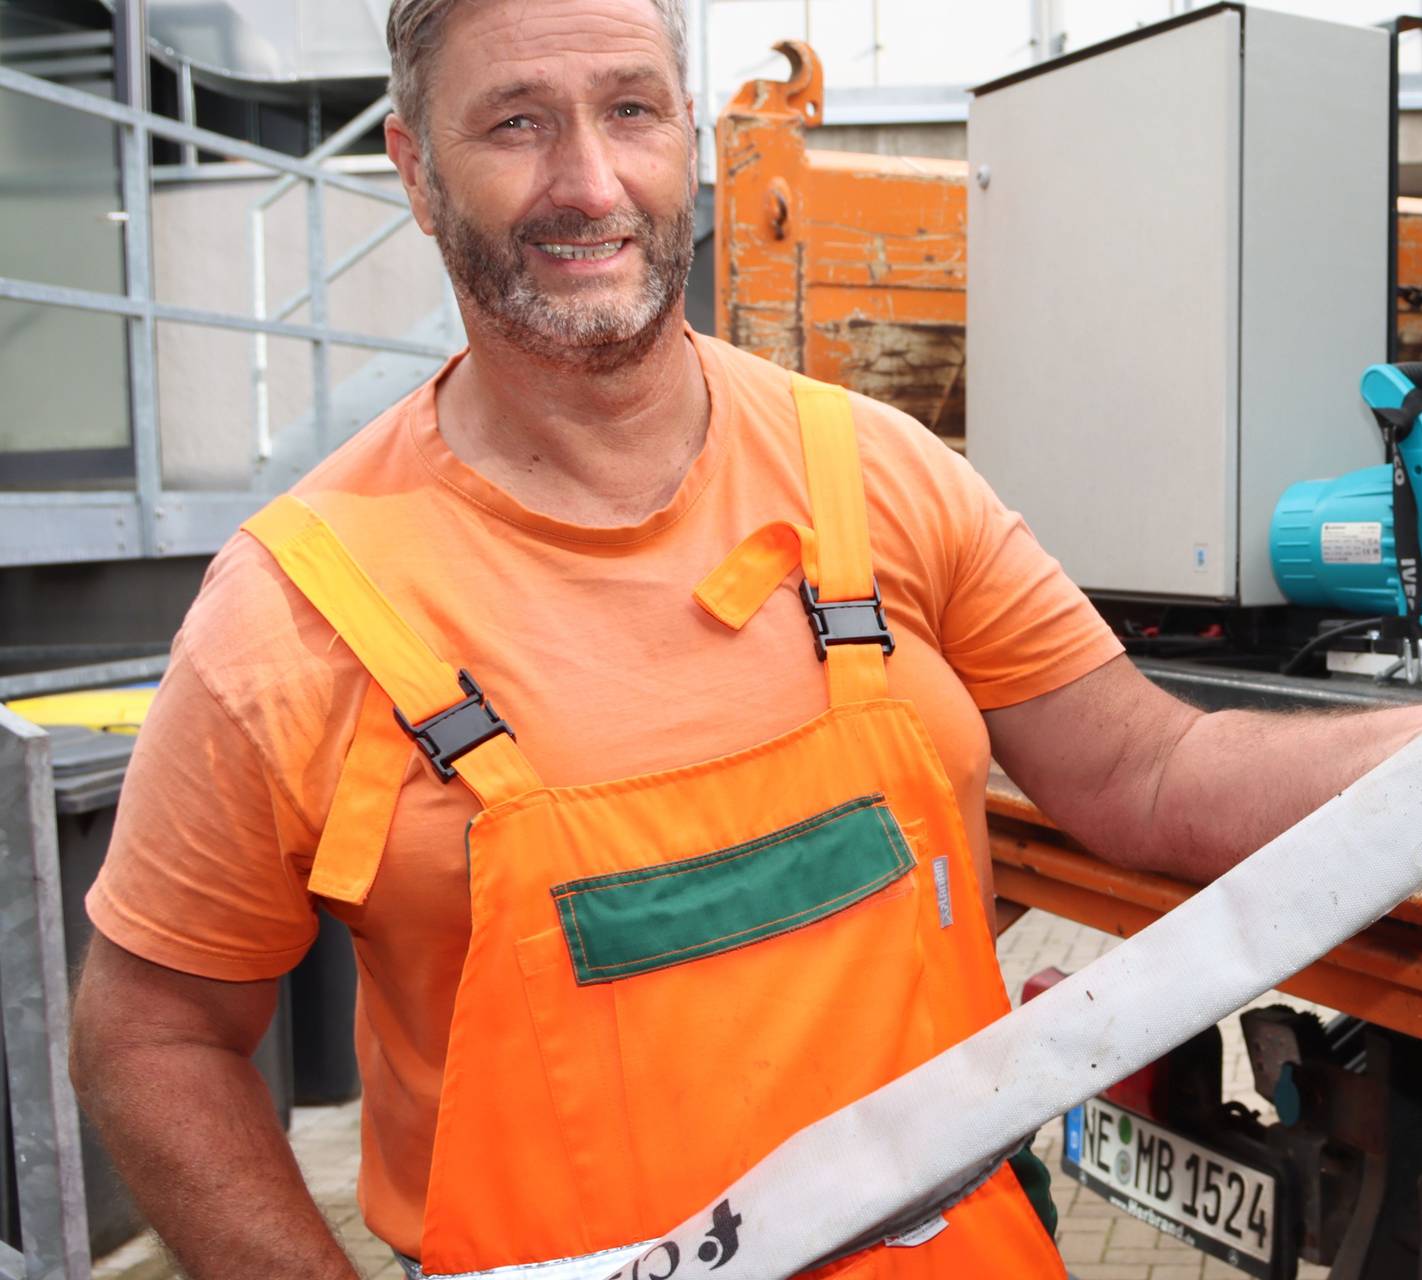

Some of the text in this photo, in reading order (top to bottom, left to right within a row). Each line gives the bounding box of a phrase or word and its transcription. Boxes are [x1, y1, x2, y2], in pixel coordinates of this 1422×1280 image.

[1084, 1103, 1267, 1249] NE MB 1524
